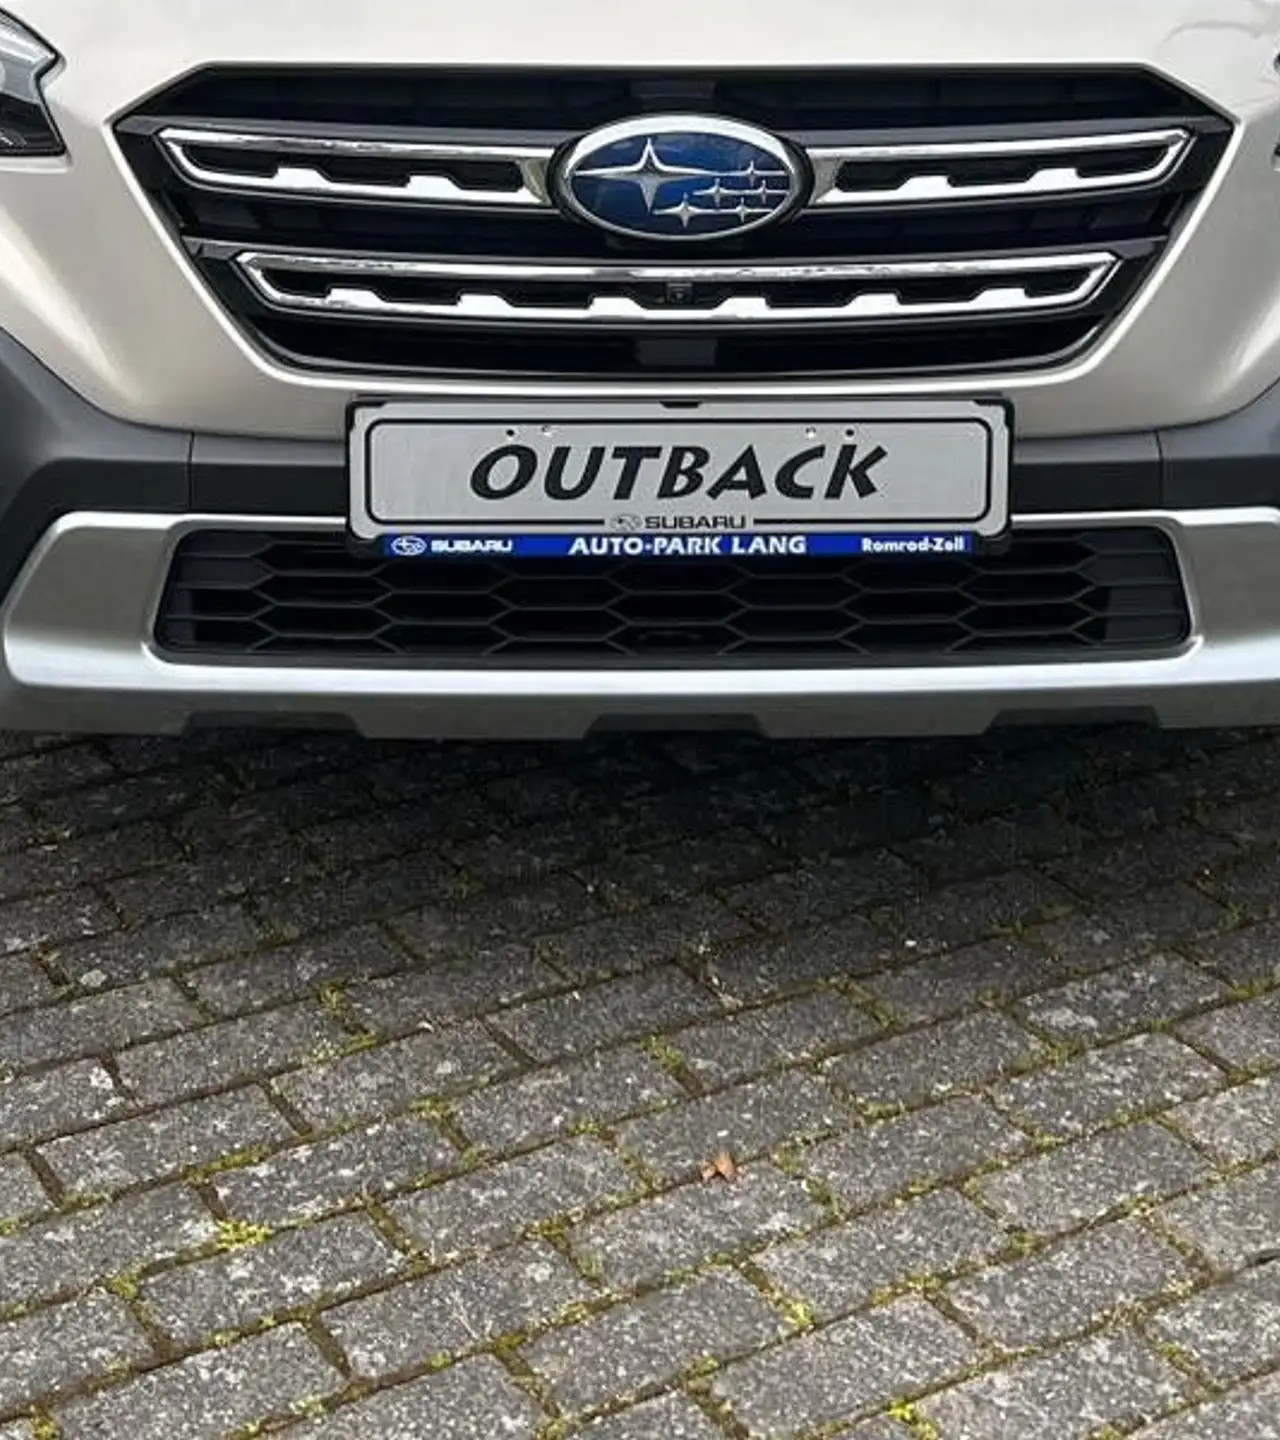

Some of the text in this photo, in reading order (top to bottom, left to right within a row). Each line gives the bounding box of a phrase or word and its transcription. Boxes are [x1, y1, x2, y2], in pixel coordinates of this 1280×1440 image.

[470, 444, 888, 501] OUTBACK
[645, 516, 746, 530] SUBARU
[431, 536, 965, 555] SUBARU AUTO-PARK LANG Romrod-Zell
